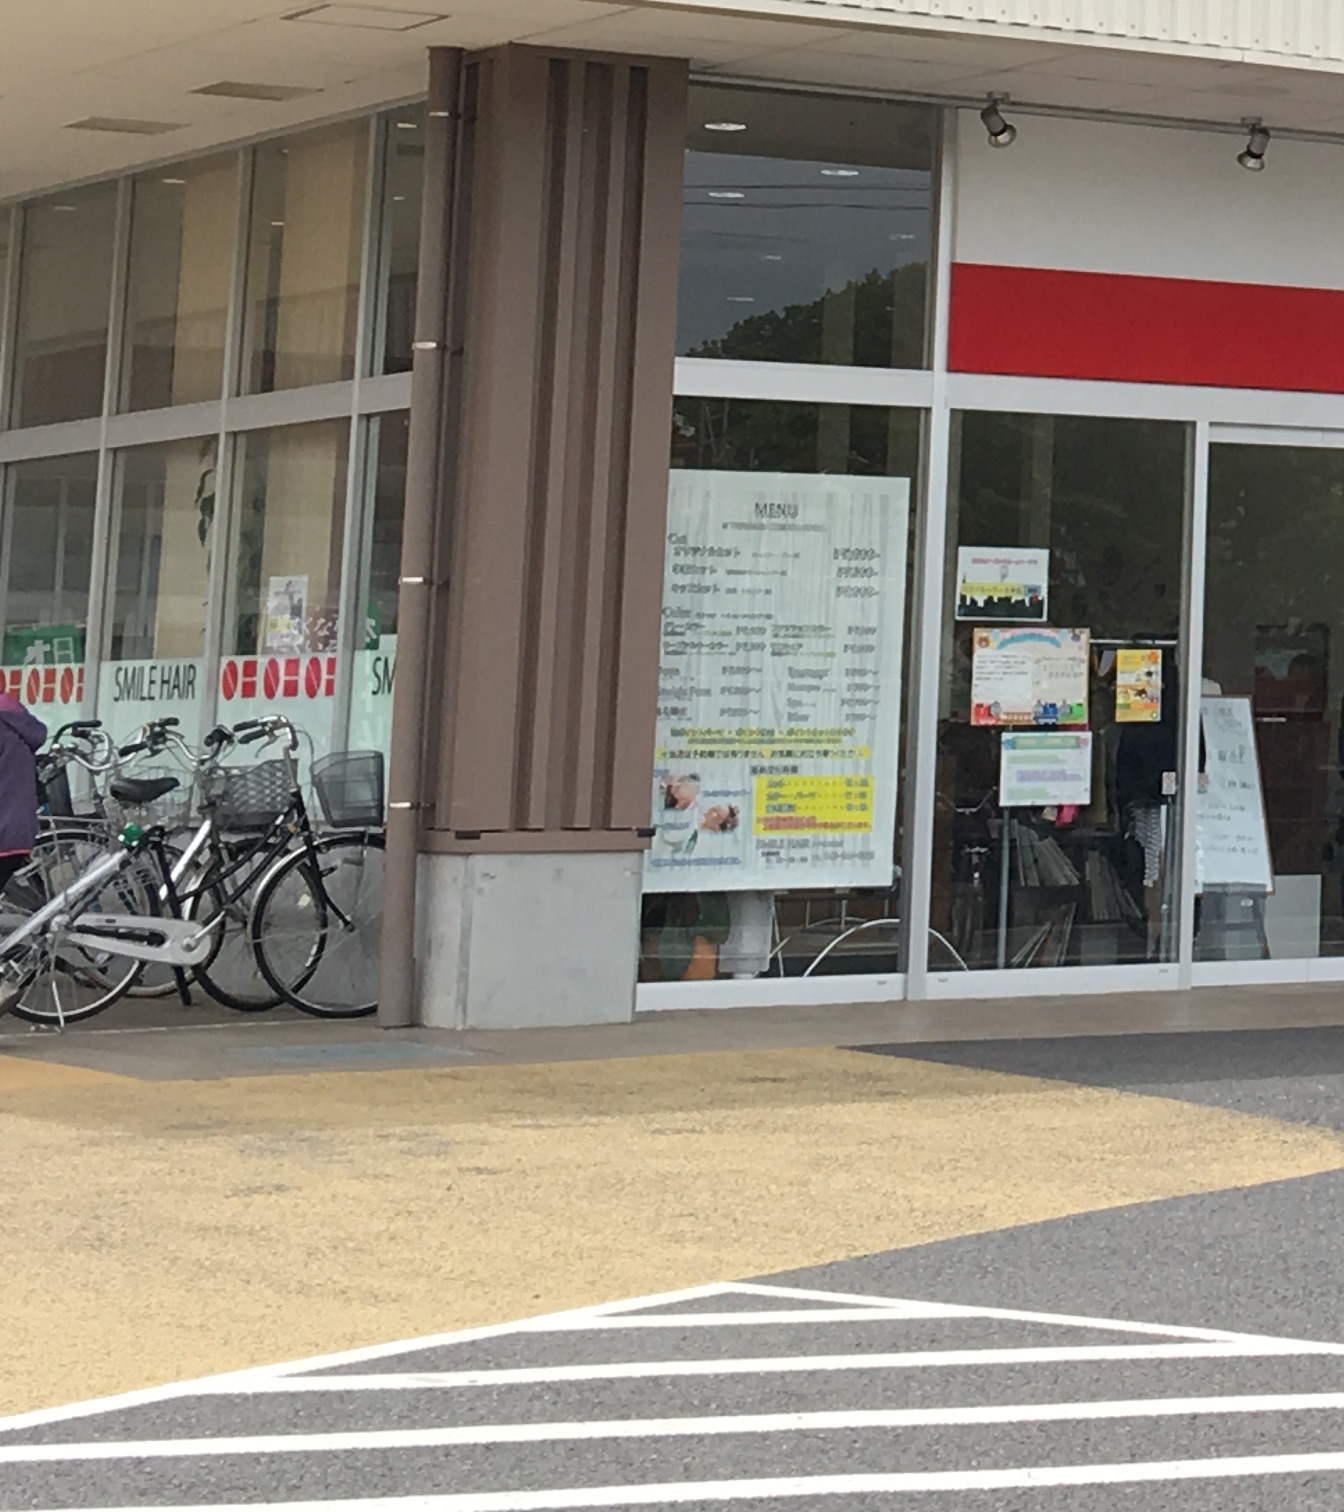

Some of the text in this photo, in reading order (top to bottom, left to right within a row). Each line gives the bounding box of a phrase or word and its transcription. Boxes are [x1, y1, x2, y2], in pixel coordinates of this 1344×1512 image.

[754, 502, 800, 519] MENU
[113, 663, 197, 702] SMILE HAIR
